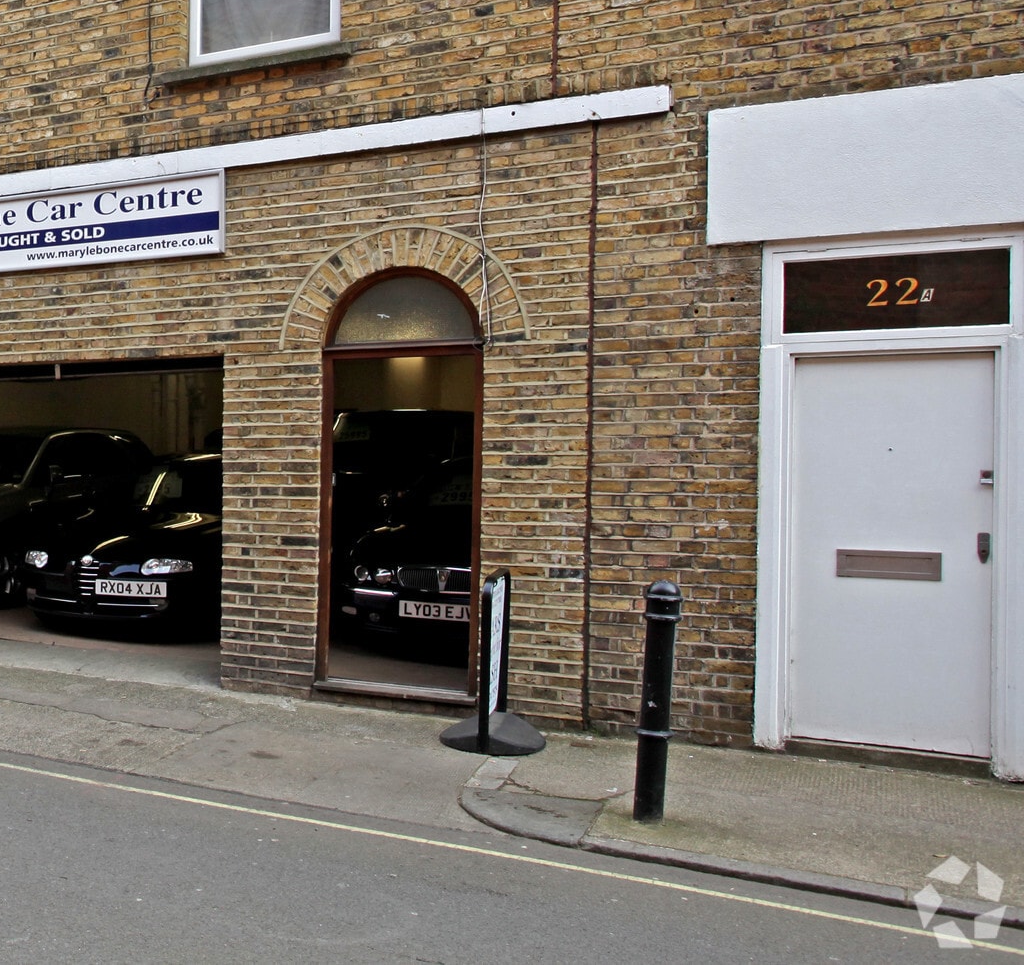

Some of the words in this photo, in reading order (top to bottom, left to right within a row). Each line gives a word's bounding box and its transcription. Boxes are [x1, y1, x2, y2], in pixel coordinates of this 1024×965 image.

[26, 199, 83, 223] Car
[93, 186, 203, 215] Centre
[44, 231, 57, 243] &
[61, 226, 105, 242] SOLD
[26, 234, 214, 261] www.marylebonecarcentre.co.uk
[100, 581, 133, 595] RX04
[136, 582, 162, 596] XJA
[404, 602, 441, 618] LY03
